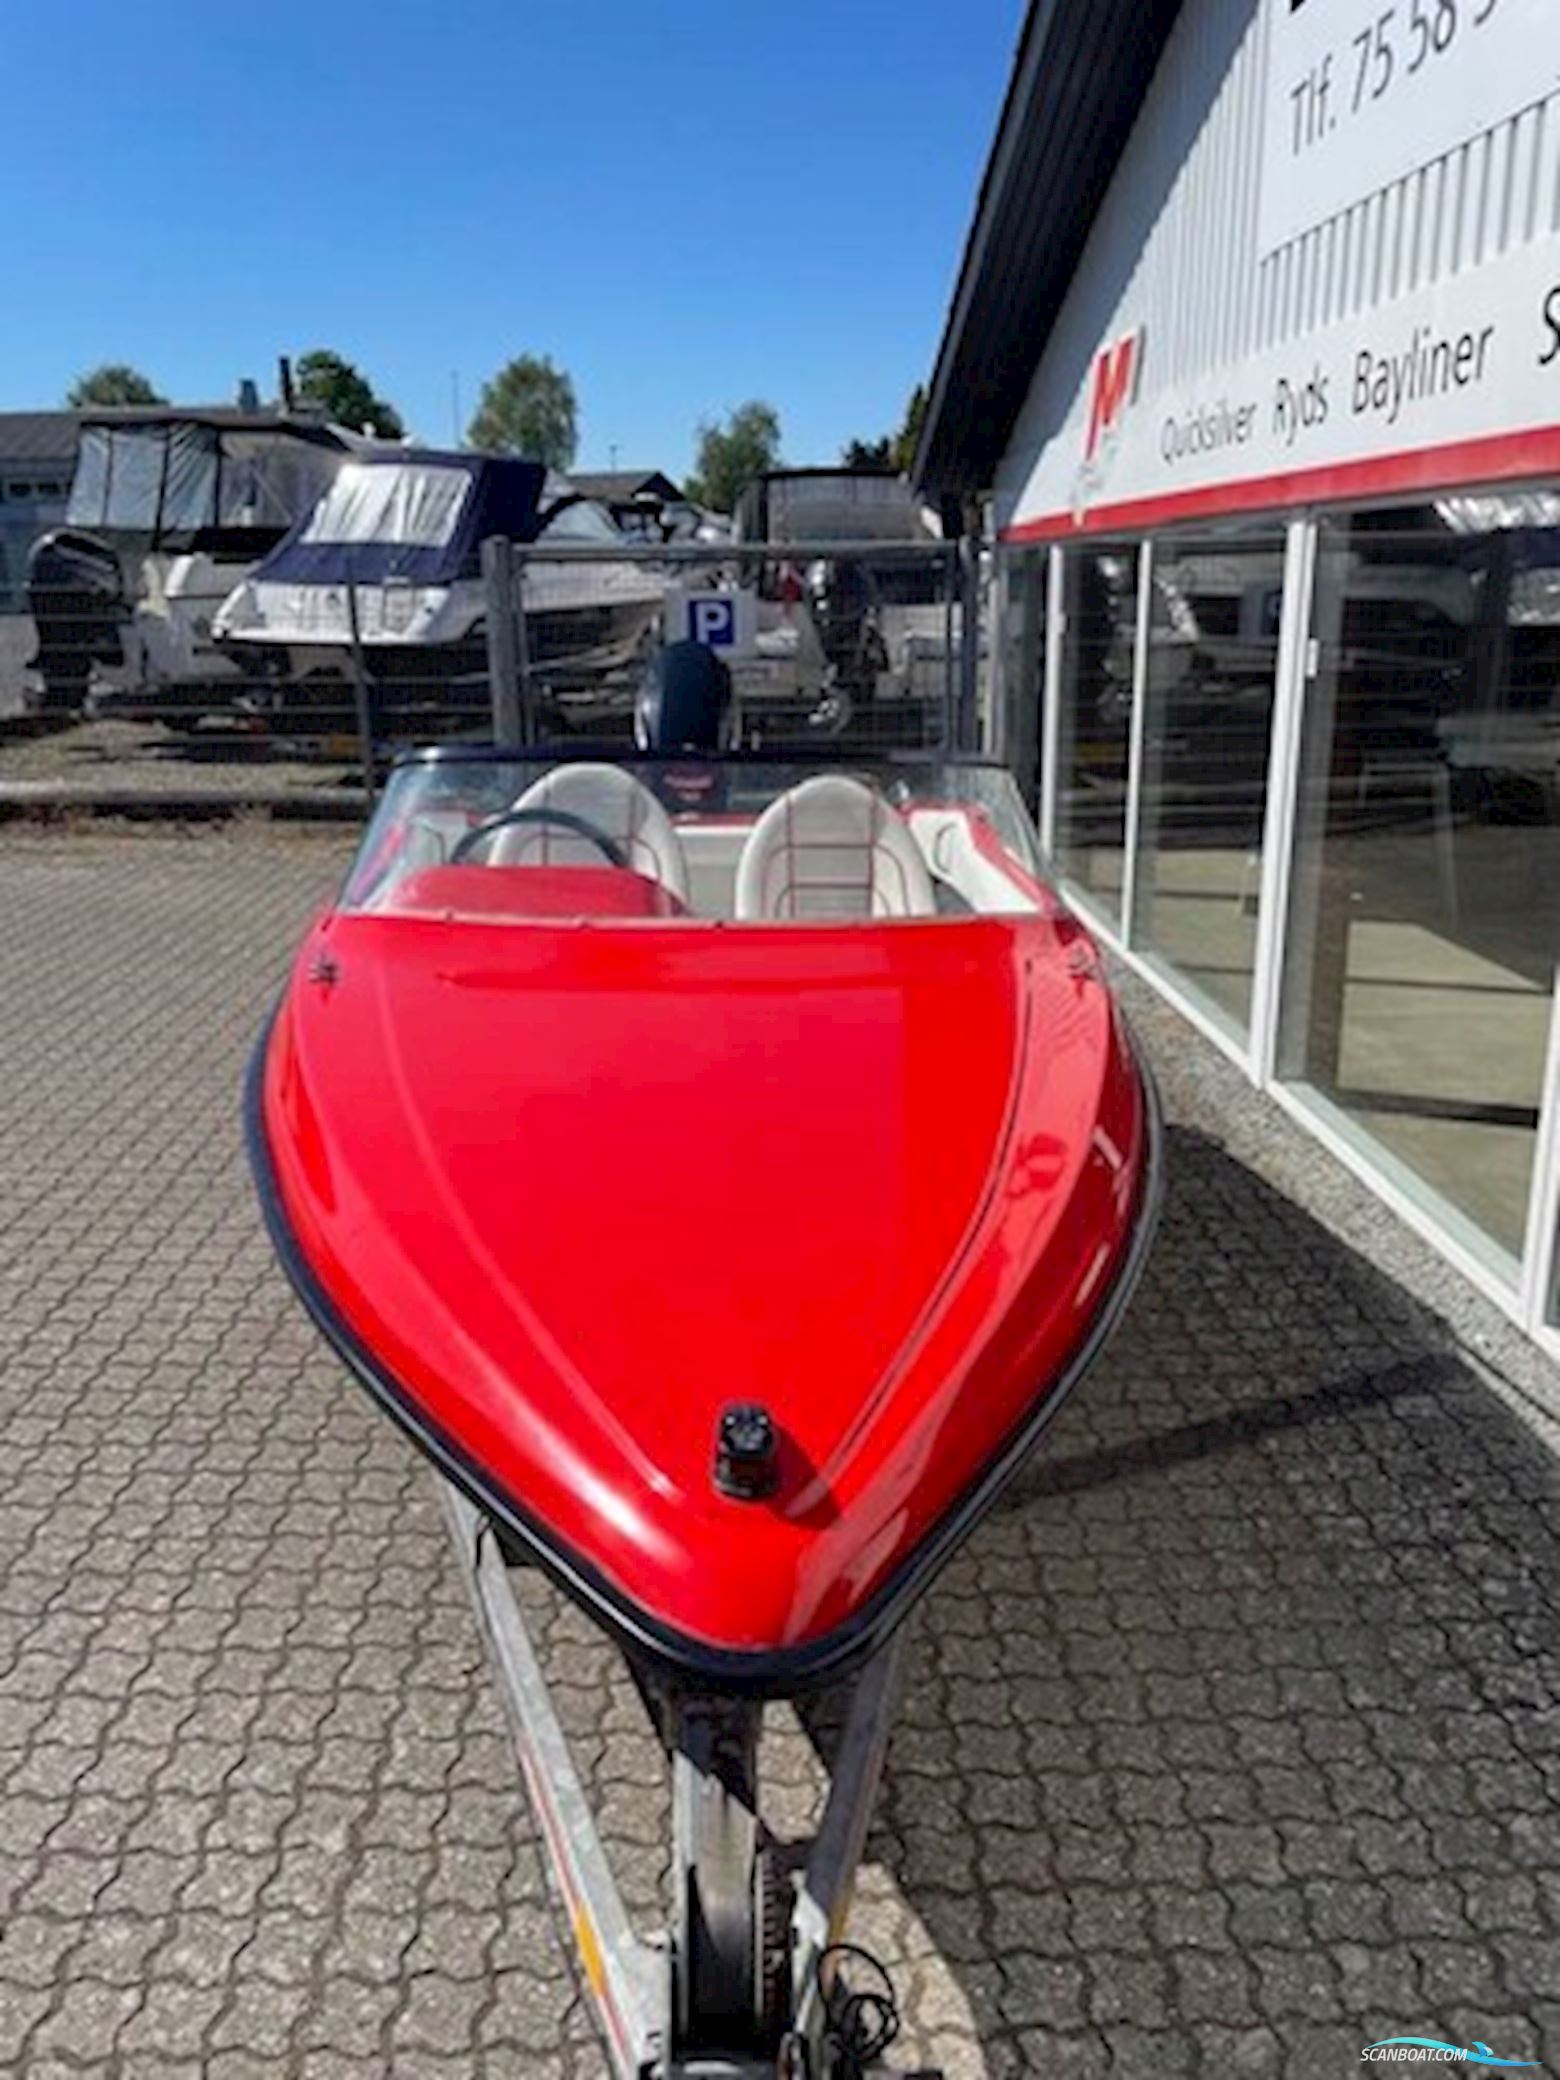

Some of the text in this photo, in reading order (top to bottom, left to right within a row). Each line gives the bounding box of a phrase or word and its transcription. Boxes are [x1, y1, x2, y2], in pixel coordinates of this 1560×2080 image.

[1290, 53, 1336, 156] Tlf.
[1352, 8, 1395, 114] 75
[1160, 397, 1257, 466] Quicksilver
[1272, 362, 1329, 447] Ryds
[1352, 324, 1494, 425] Bayliner
[696, 602, 729, 644] P
